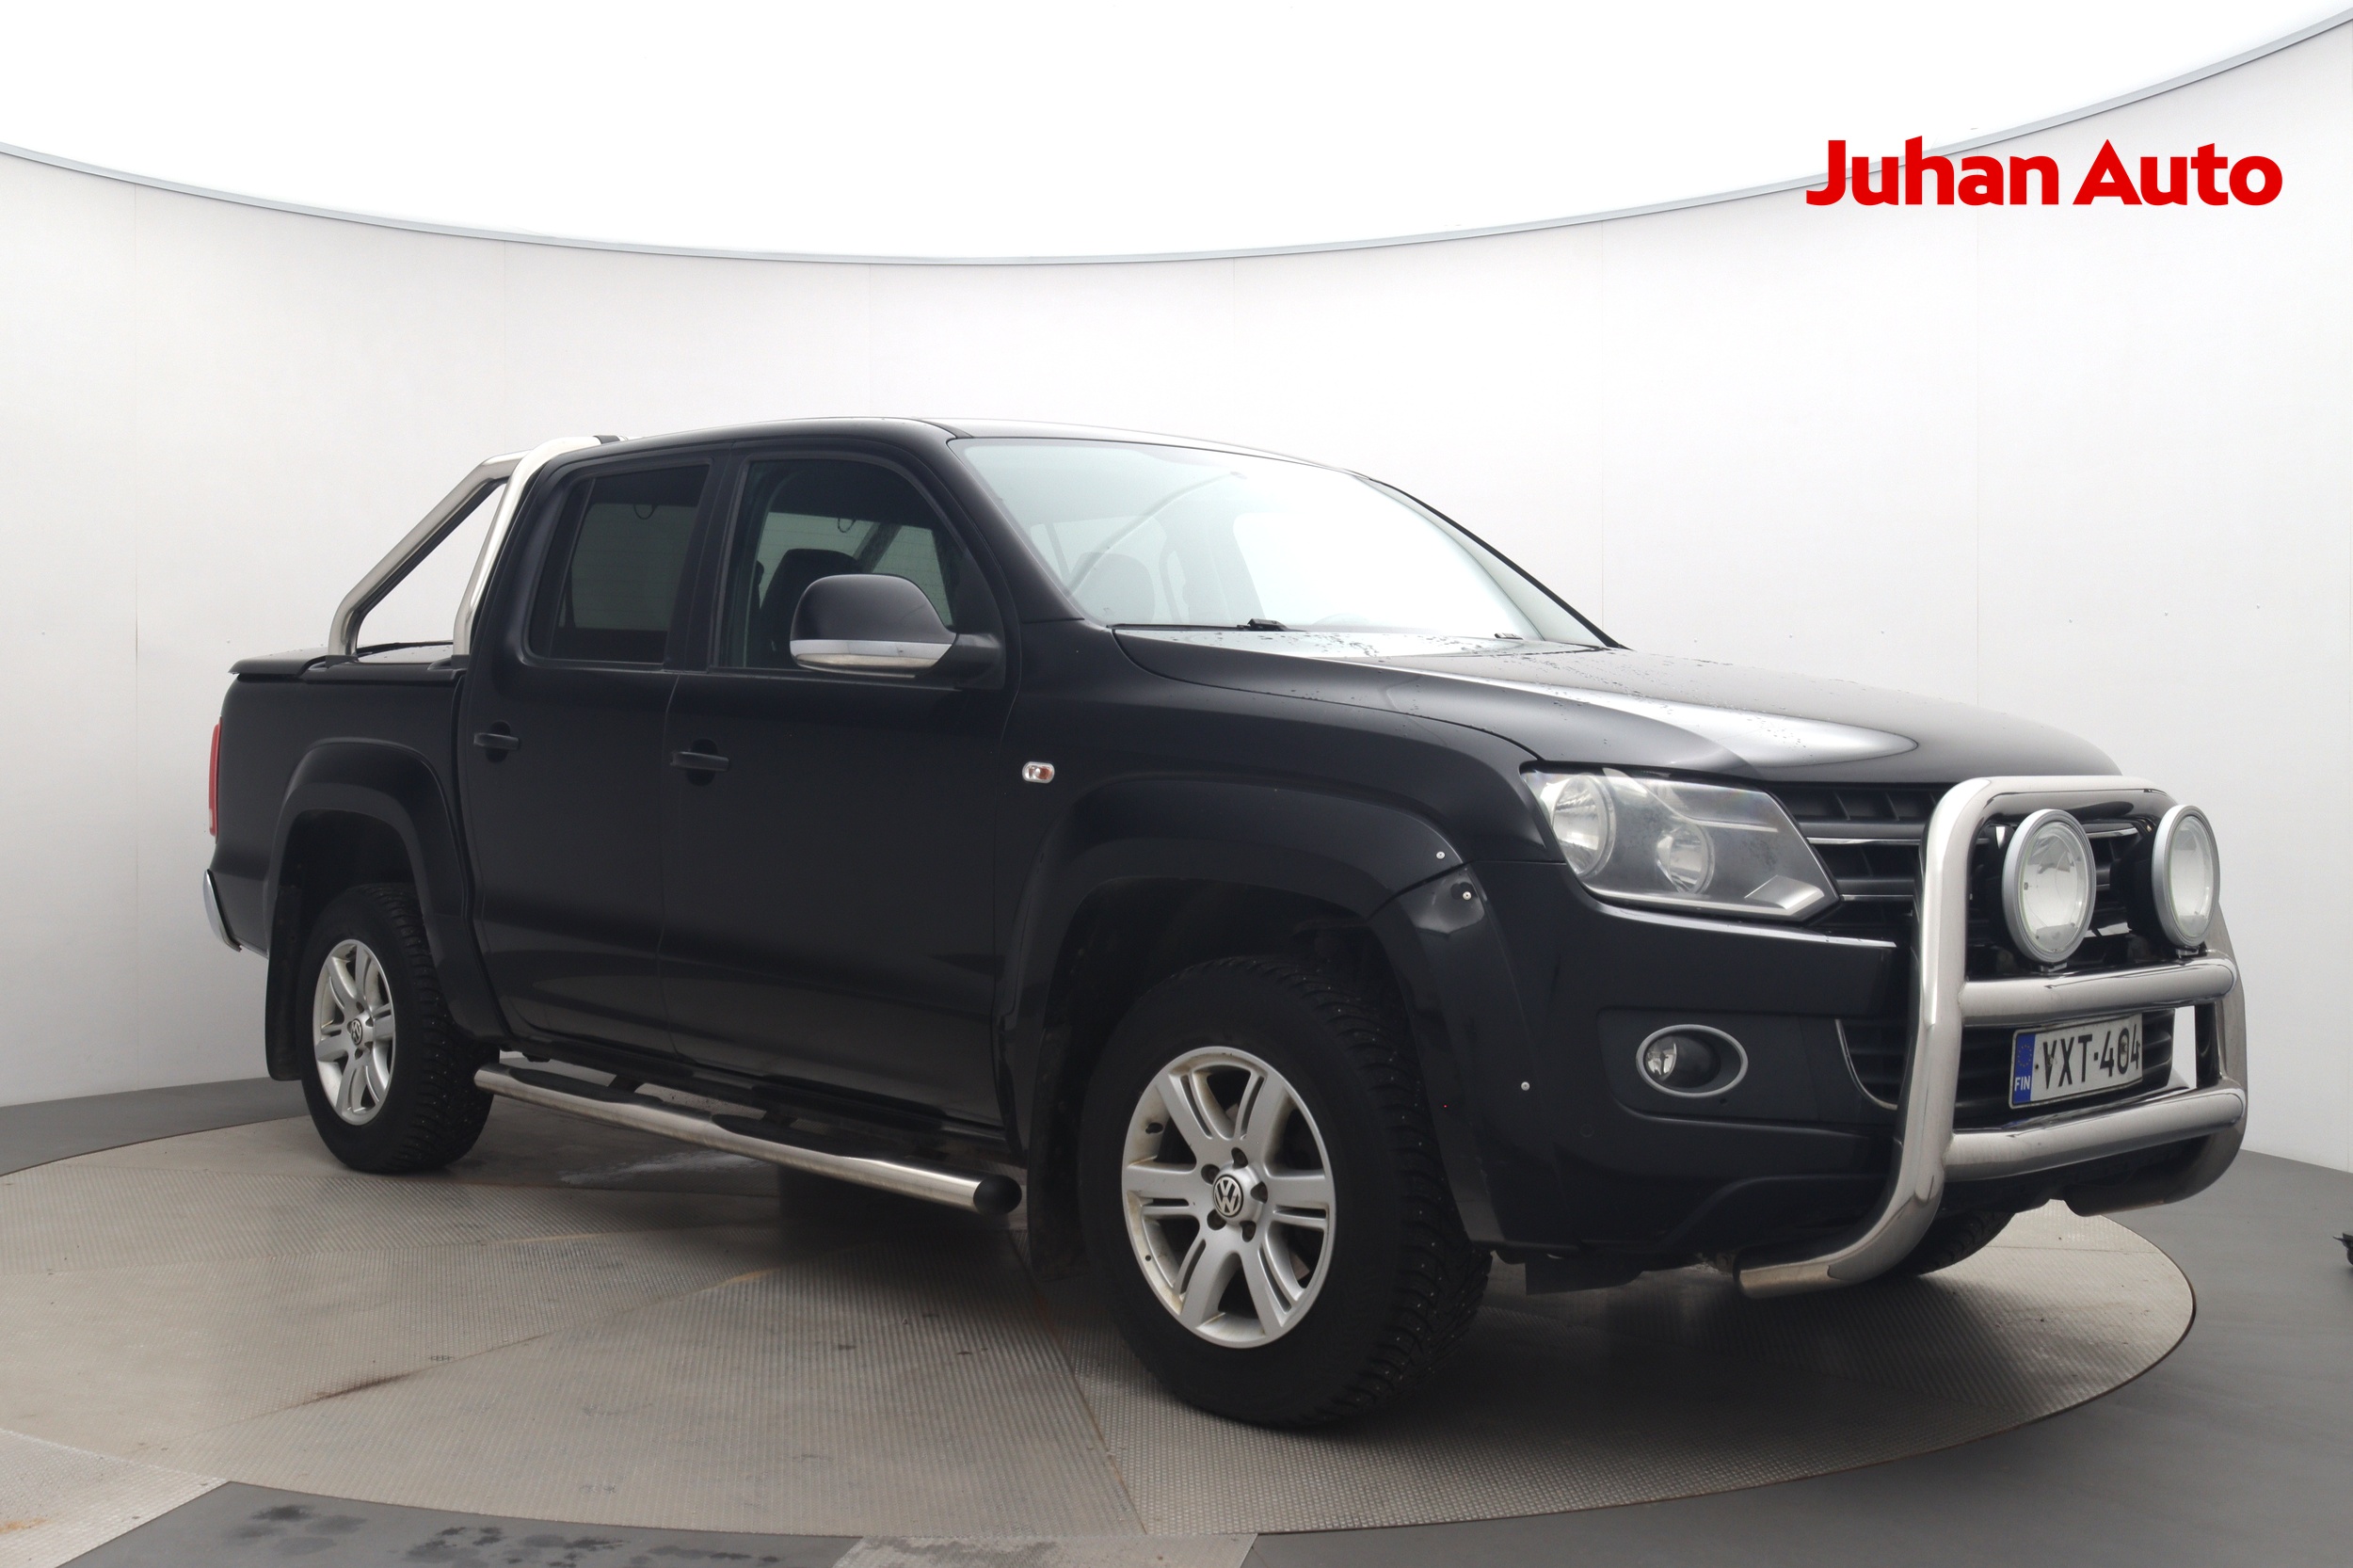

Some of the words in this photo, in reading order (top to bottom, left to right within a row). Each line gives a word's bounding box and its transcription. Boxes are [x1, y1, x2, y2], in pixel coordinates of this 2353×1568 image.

[2042, 1024, 2140, 1090] VXT-404
[2014, 1075, 2031, 1092] FIN
[1214, 1176, 1242, 1217] VW
